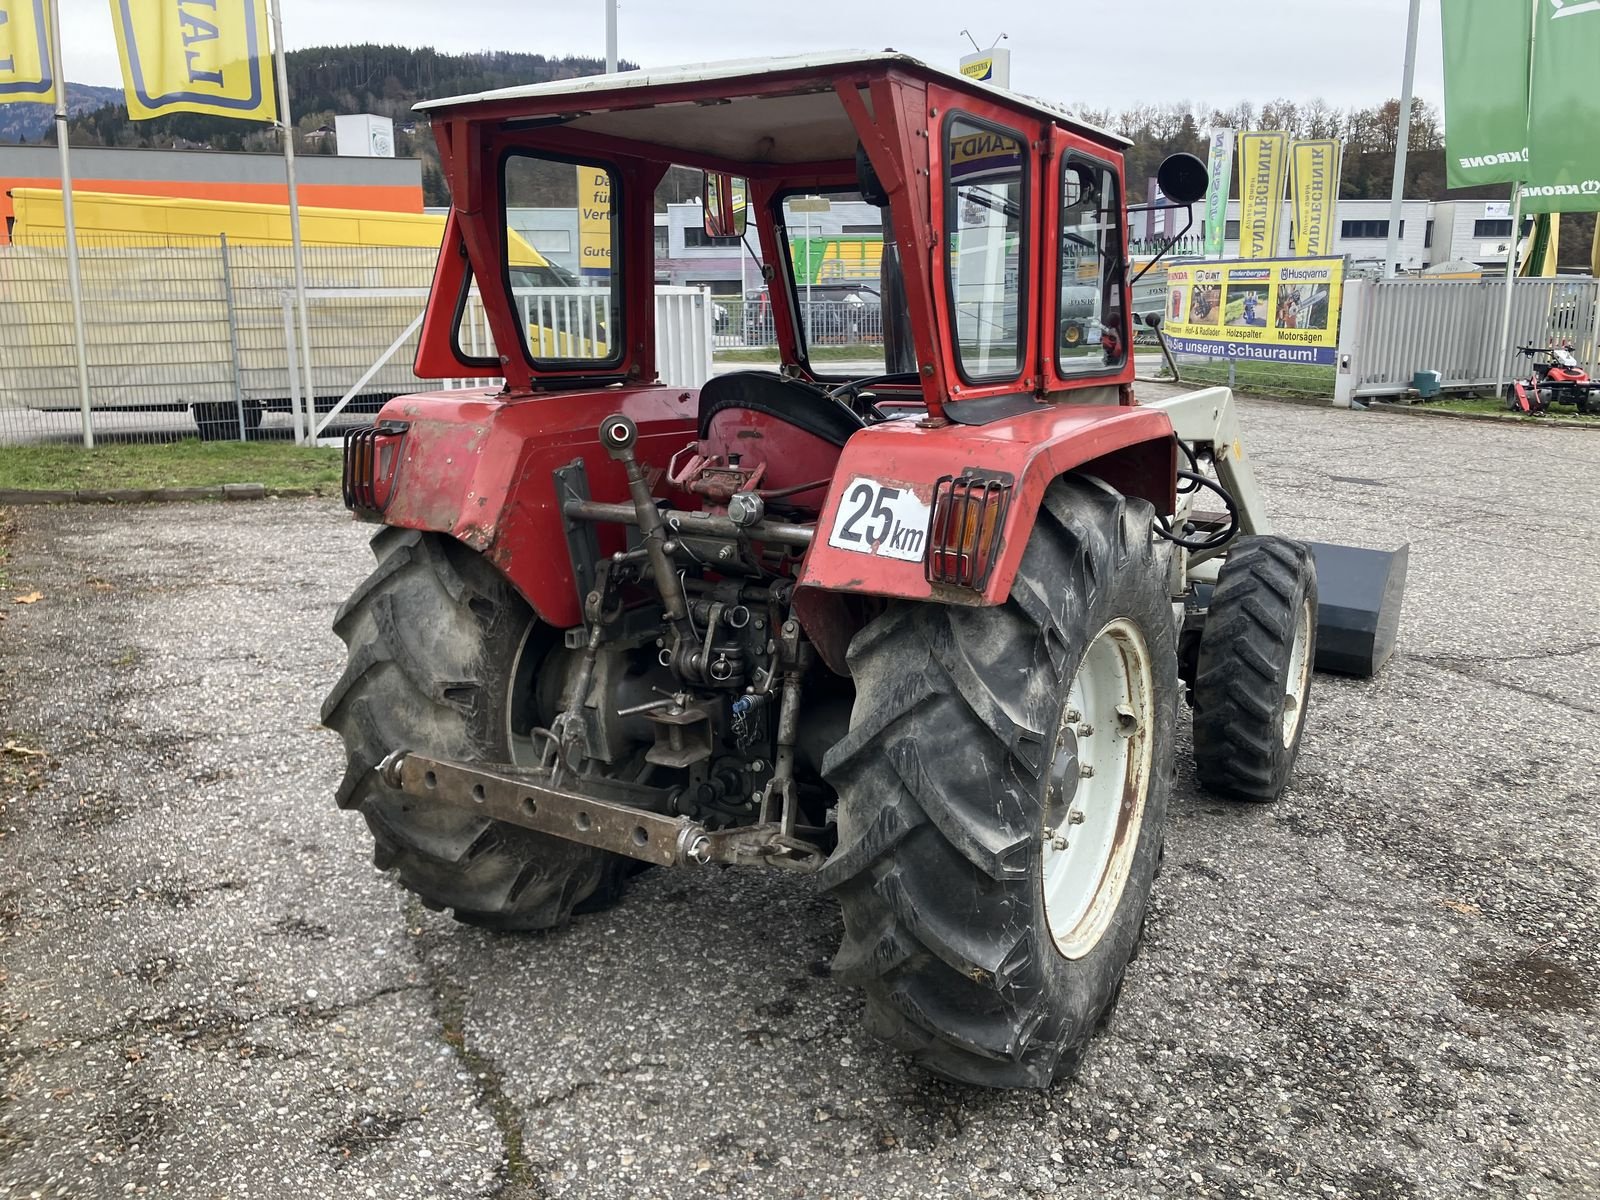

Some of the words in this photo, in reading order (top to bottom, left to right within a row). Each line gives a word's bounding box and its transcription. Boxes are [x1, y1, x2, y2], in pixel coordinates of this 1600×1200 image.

[1288, 268, 1328, 280] Husqvarna
[1226, 328, 1262, 339] Holzspalter
[1278, 330, 1323, 343] Motorsägen
[1185, 342, 1225, 355] unseren
[1228, 343, 1318, 362] Schauraum!
[839, 483, 900, 547] 25
[889, 519, 924, 553] km
